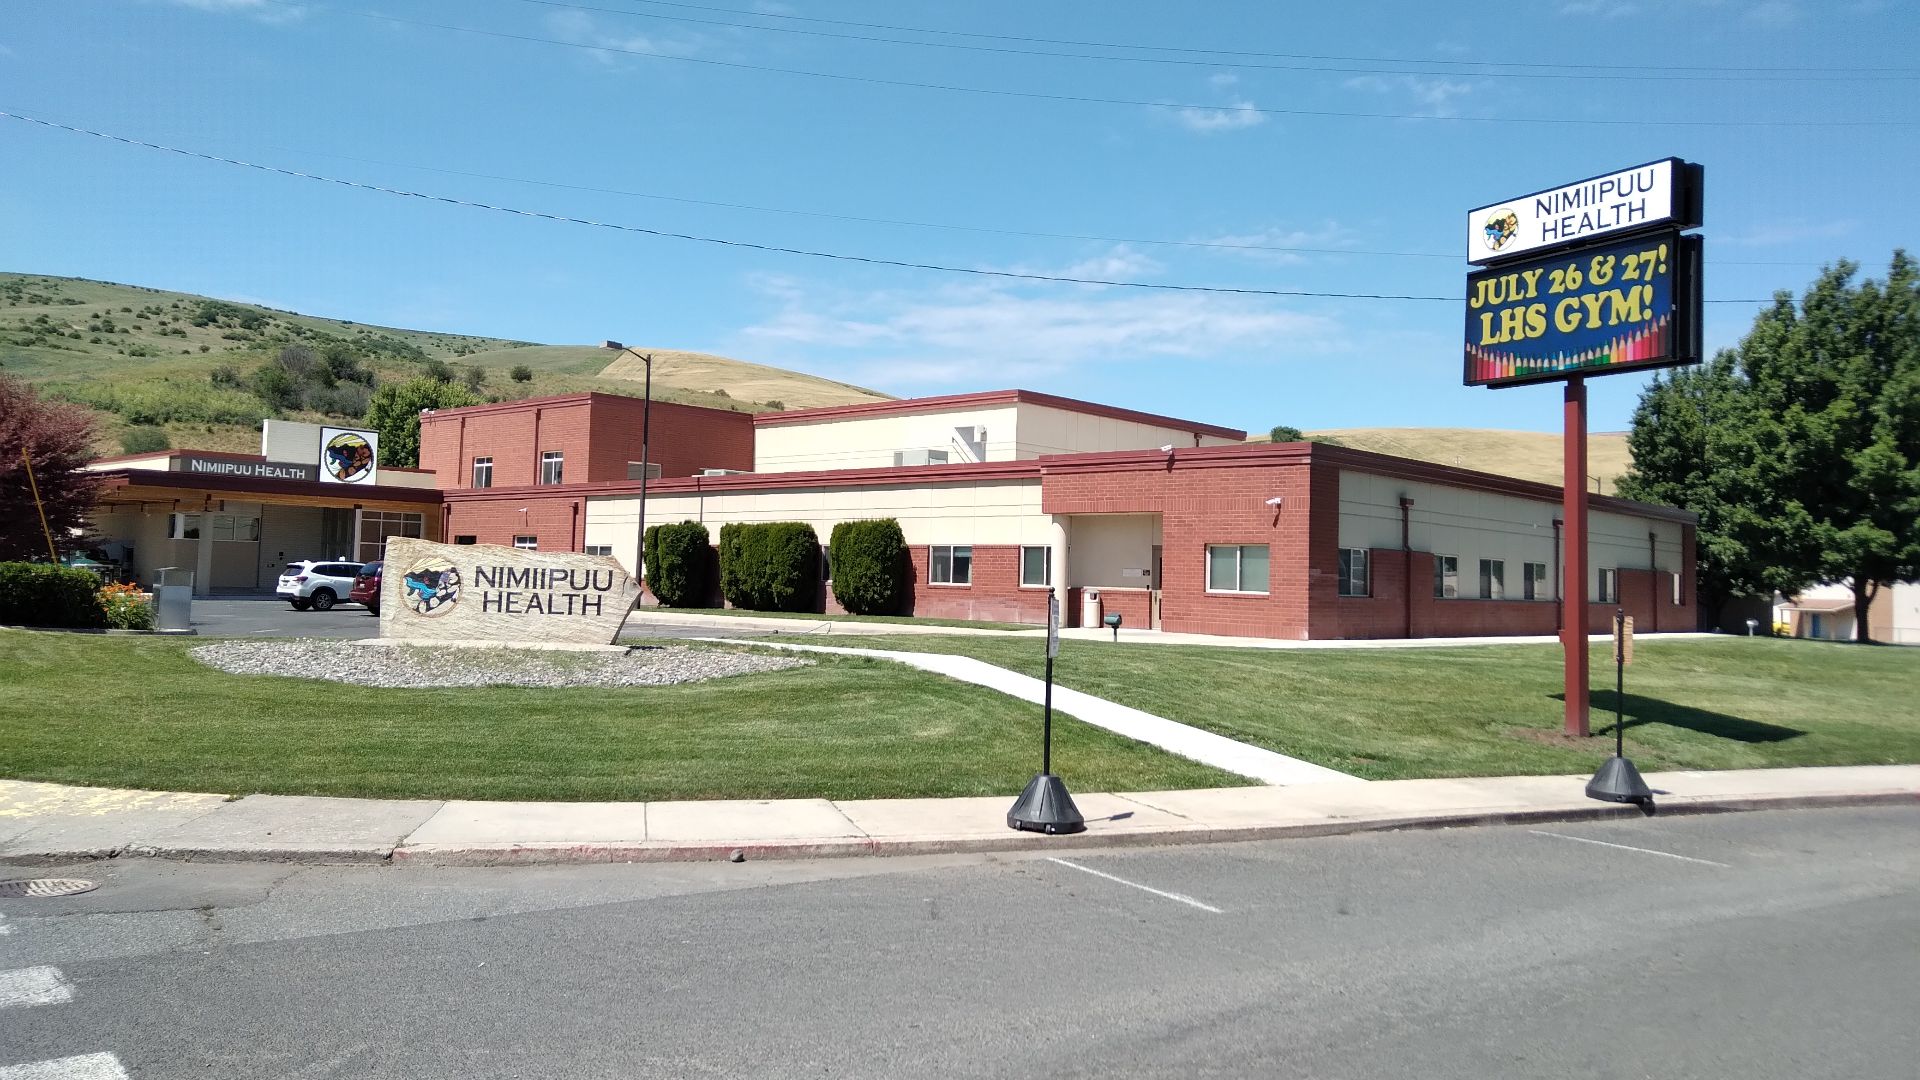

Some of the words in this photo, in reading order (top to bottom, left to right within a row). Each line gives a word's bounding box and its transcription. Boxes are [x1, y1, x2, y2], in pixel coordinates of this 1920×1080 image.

[1536, 169, 1655, 219] NIMIIPUU
[1542, 198, 1646, 242] HEALTH
[1471, 268, 1544, 309] JULY
[1549, 264, 1583, 294] 26
[1589, 255, 1616, 285] &
[1621, 243, 1668, 281] 27!
[1480, 303, 1547, 345] LHS
[1554, 284, 1654, 333] GYM!
[474, 565, 613, 591] NIMIIPUU
[482, 591, 602, 616] HEALTH
